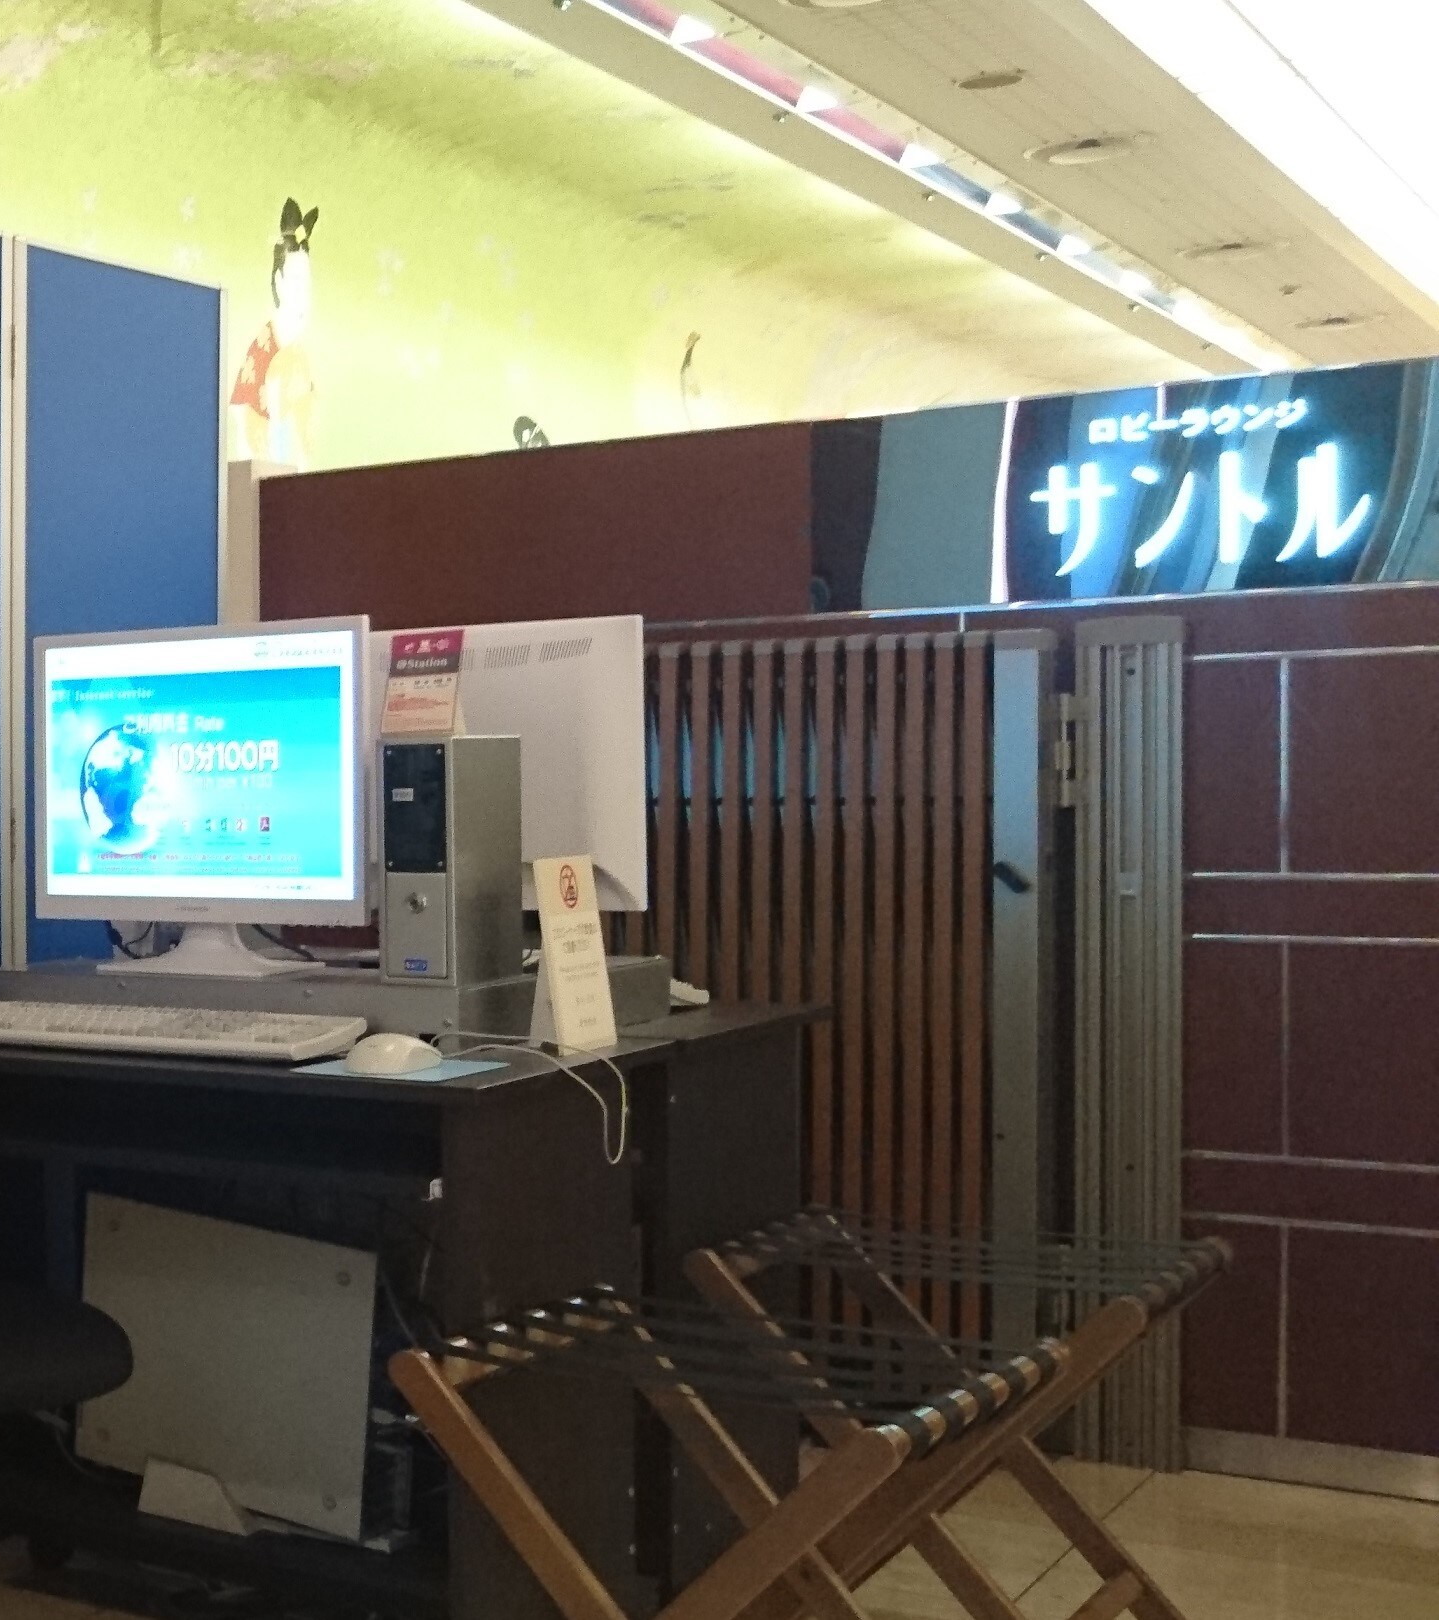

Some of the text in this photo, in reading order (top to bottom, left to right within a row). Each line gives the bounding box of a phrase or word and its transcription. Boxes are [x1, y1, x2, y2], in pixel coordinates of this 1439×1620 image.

[1088, 399, 1308, 445] ロビーラウンジ
[1029, 442, 1372, 577] サントル
[169, 738, 280, 773] 10分100円
